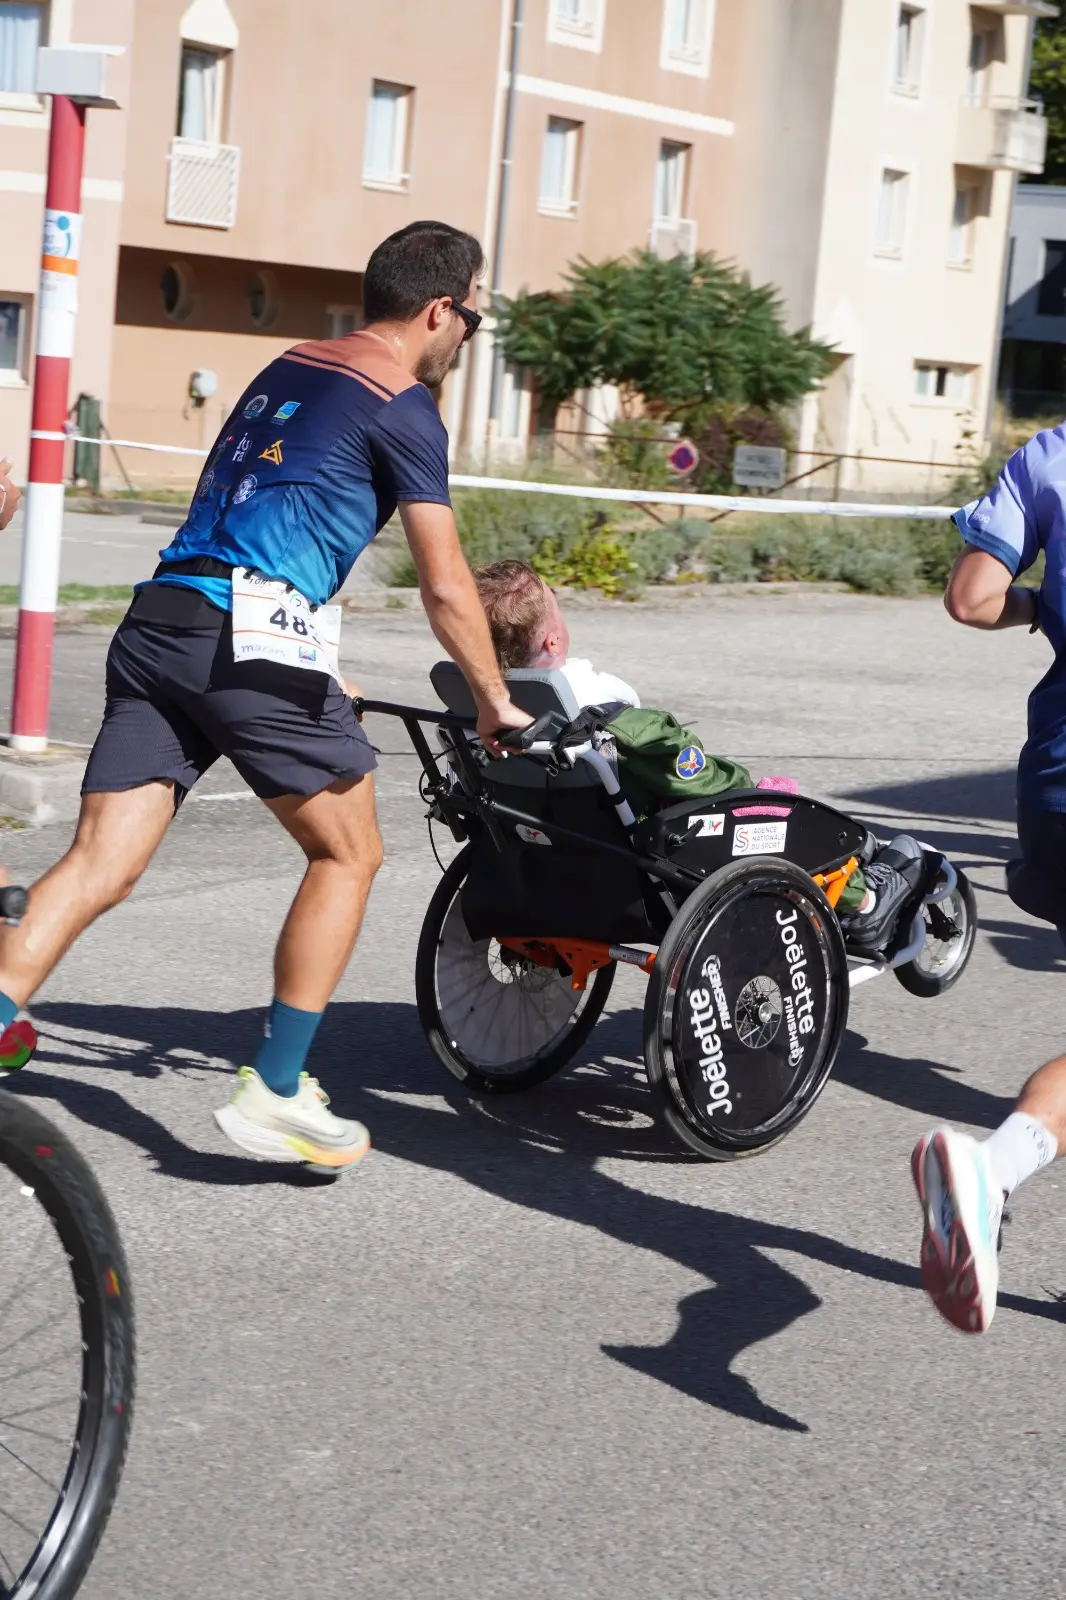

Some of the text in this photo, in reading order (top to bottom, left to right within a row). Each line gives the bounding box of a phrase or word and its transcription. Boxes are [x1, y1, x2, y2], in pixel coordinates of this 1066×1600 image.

[241, 644, 286, 658] mazars
[752, 834, 785, 842] NATIONALE
[753, 826, 777, 834] AGENCE
[708, 963, 733, 1031] FINISHER
[776, 909, 814, 1034] Joëlette
[689, 988, 733, 1117] Joëlette
[784, 995, 801, 1058] FINISHER
